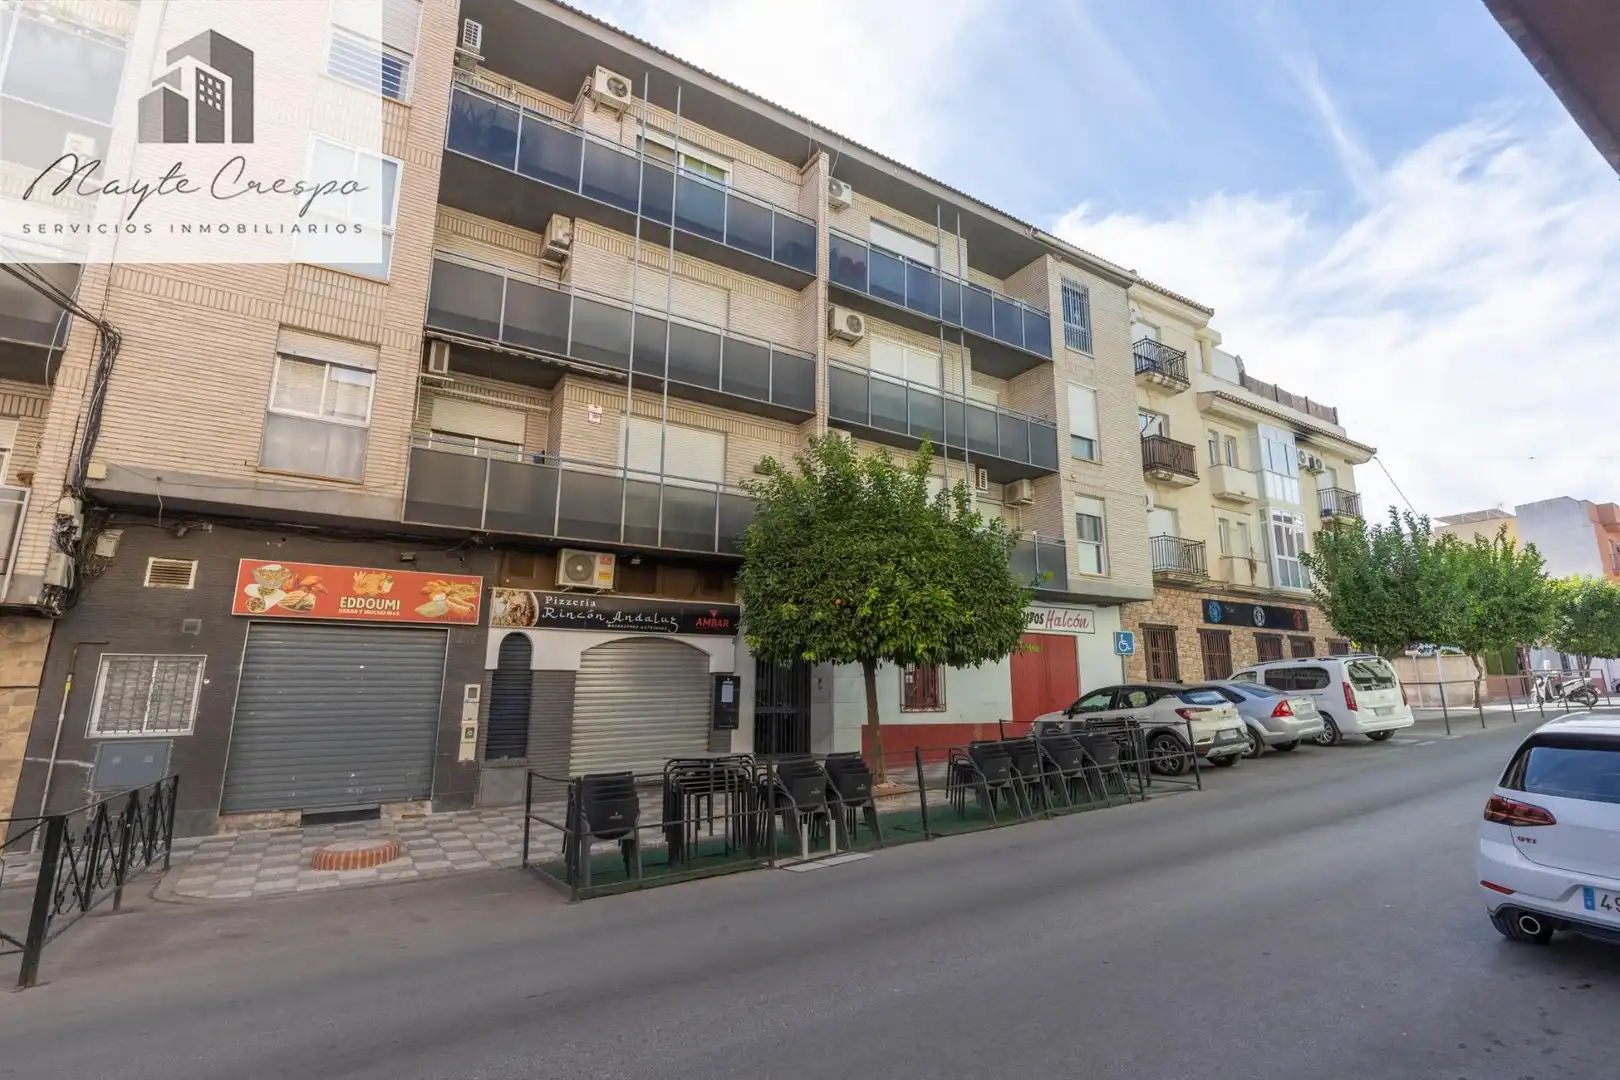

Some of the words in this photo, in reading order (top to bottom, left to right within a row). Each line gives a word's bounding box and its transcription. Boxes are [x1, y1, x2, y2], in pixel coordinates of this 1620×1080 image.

[339, 596, 400, 610] EDDOUMI
[541, 606, 606, 621] Rincón
[606, 610, 679, 633] Andaluz
[695, 617, 730, 629] AMBAR
[1045, 609, 1089, 630] Halcón
[1517, 835, 1537, 845] GTI
